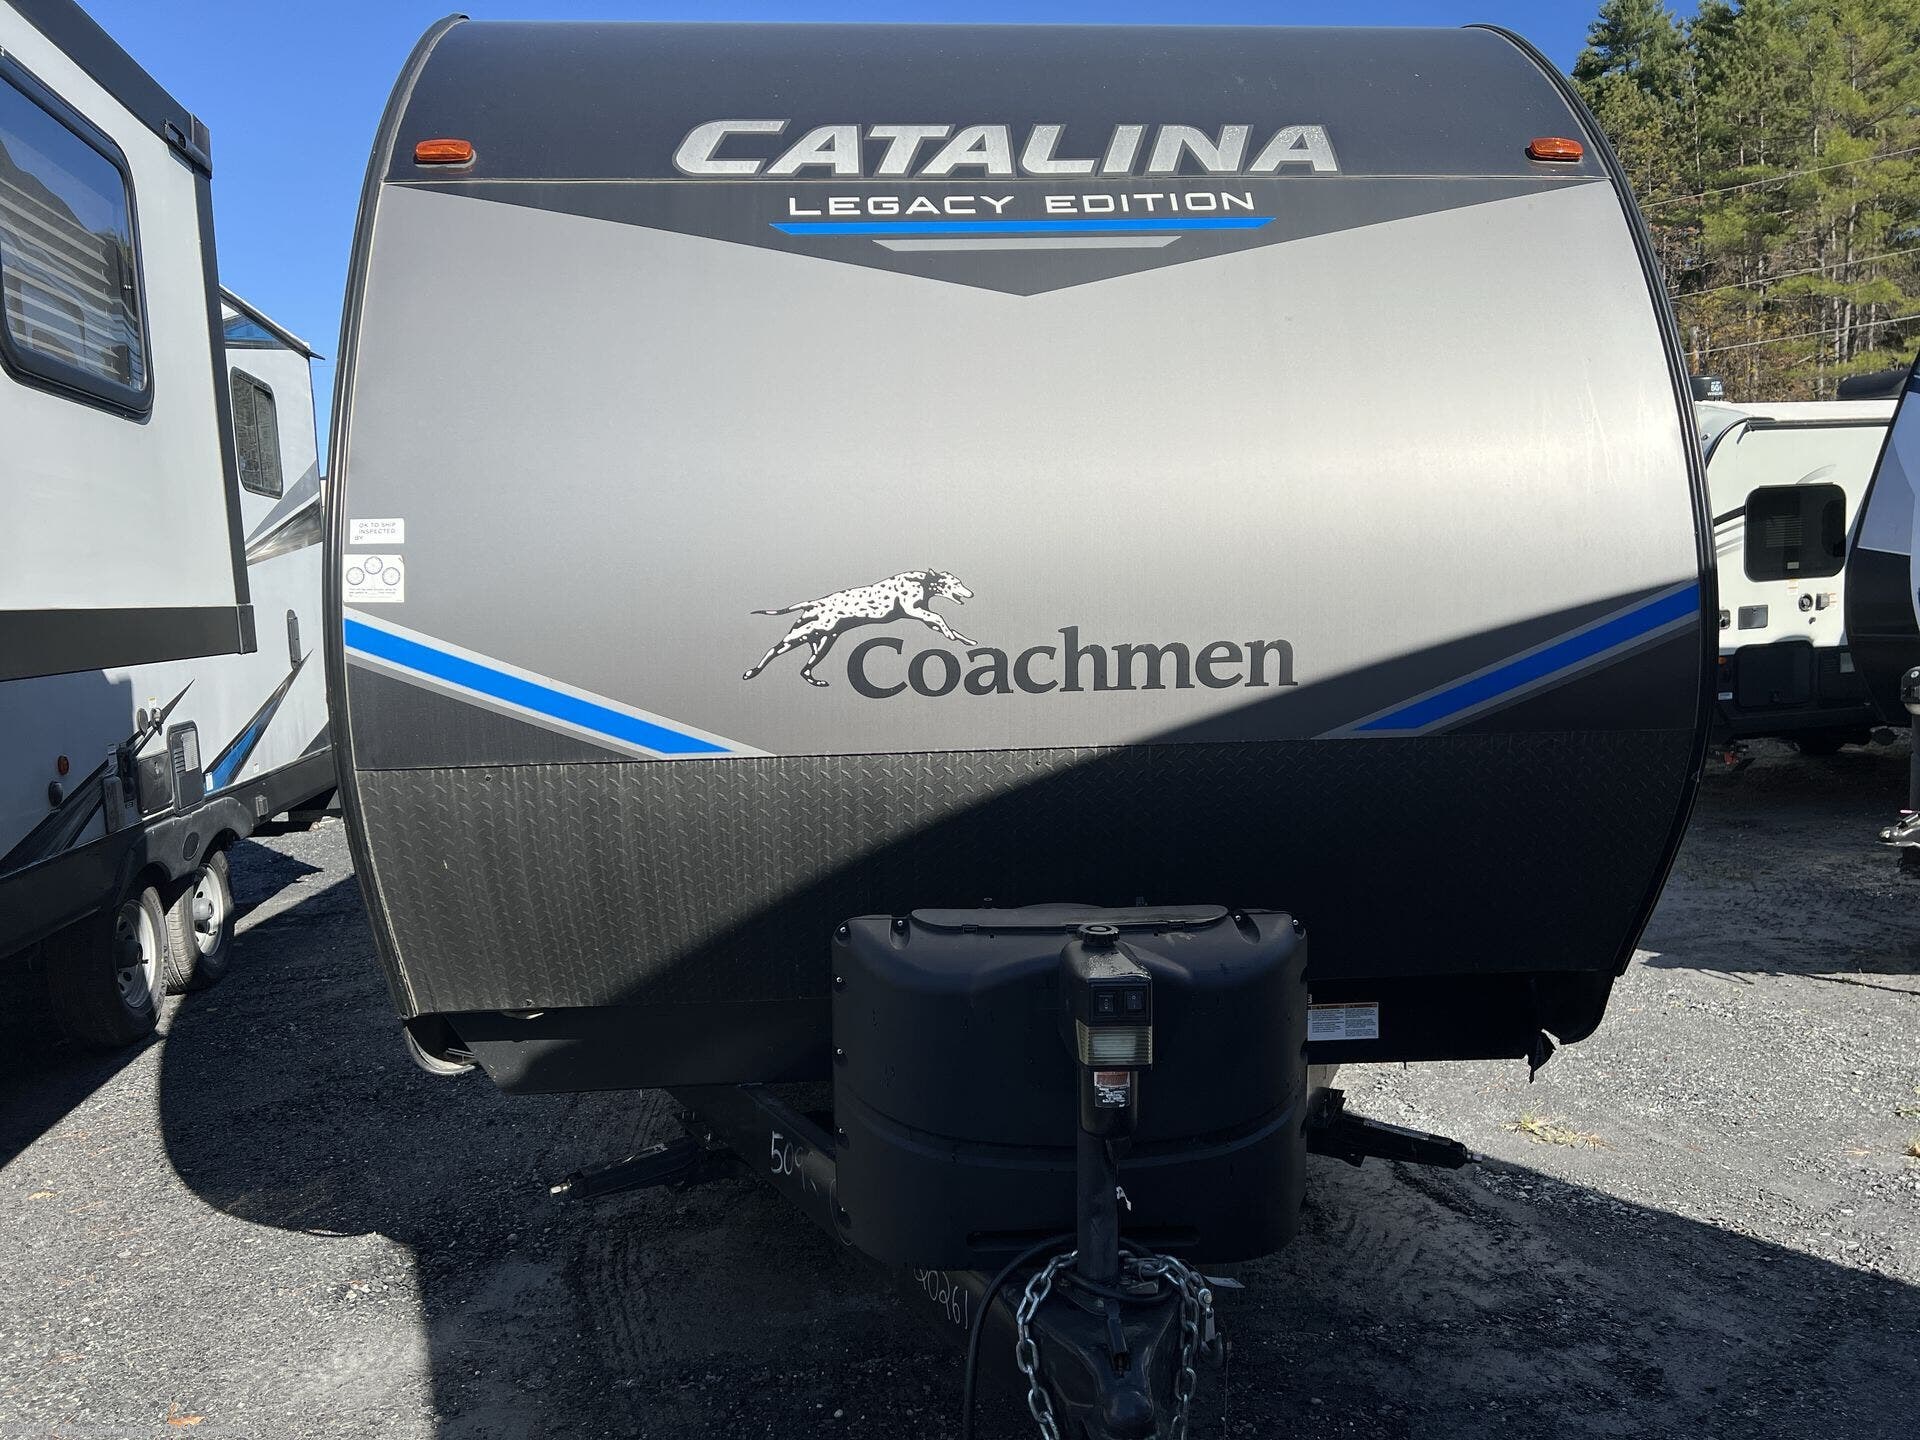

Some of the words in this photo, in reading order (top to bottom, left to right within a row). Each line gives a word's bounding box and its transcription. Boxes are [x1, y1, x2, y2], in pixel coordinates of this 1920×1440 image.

[674, 118, 1340, 176] CATALINA
[788, 194, 1016, 216] LEGACY
[1045, 191, 1255, 213] EDITION
[846, 625, 1299, 699] Coachmen
